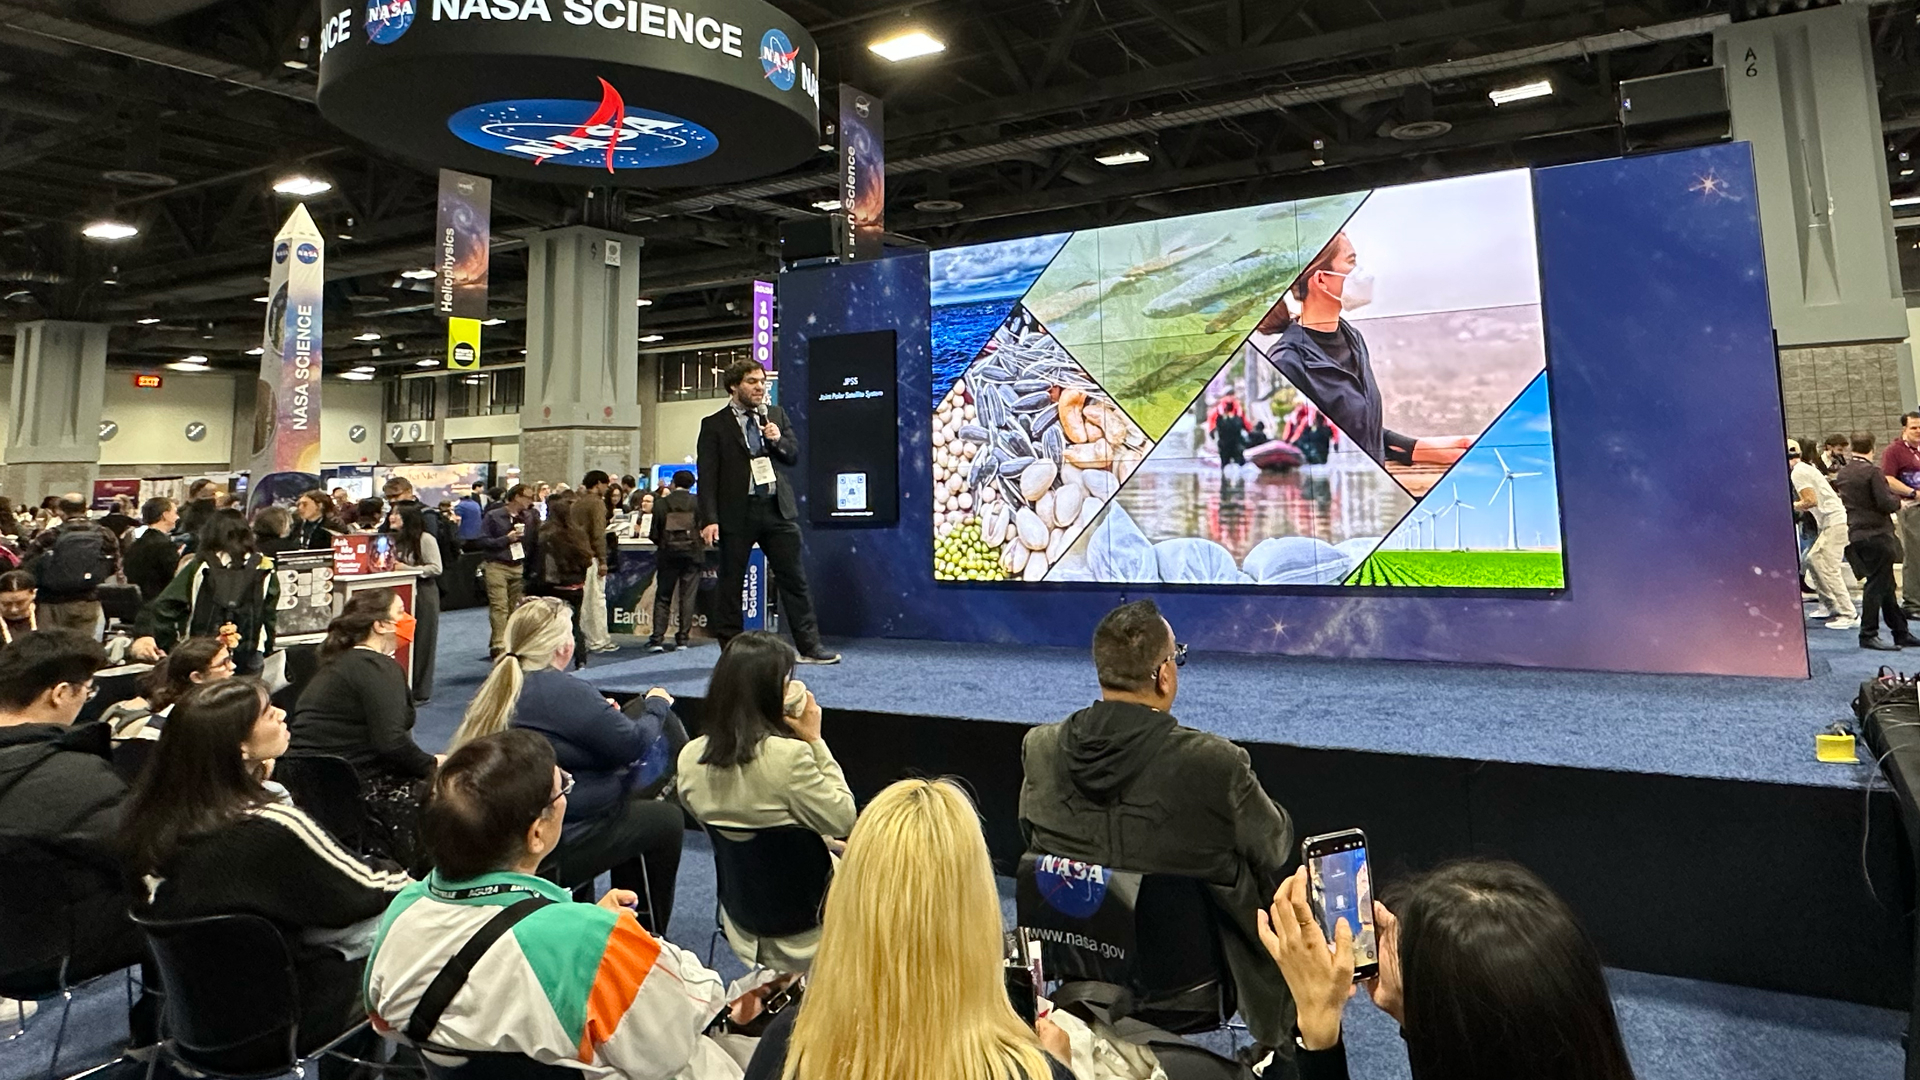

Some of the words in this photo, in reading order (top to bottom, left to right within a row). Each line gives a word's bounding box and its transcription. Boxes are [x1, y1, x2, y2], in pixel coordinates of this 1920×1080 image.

[368, 2, 414, 23] NASA
[432, 0, 553, 21] NASA
[562, 0, 743, 58] SCIENCE
[763, 46, 796, 75] NASA
[505, 115, 684, 159] NASA
[845, 145, 856, 210] Science
[298, 249, 319, 259] NASA
[440, 227, 456, 313] Heliophysics
[296, 304, 313, 380] SCIENCE
[138, 375, 160, 387] EXIT
[842, 376, 859, 386] JPSS
[293, 384, 308, 431] NASA
[333, 538, 348, 547] Ask
[340, 545, 354, 554] Me
[333, 551, 356, 561] About
[702, 569, 718, 579] ASA
[747, 564, 758, 619] Science
[613, 607, 650, 626] Earth
[1040, 853, 1105, 885] NASA
[467, 885, 499, 898] AGU24
[1028, 925, 1126, 960] www.nasa.gov
